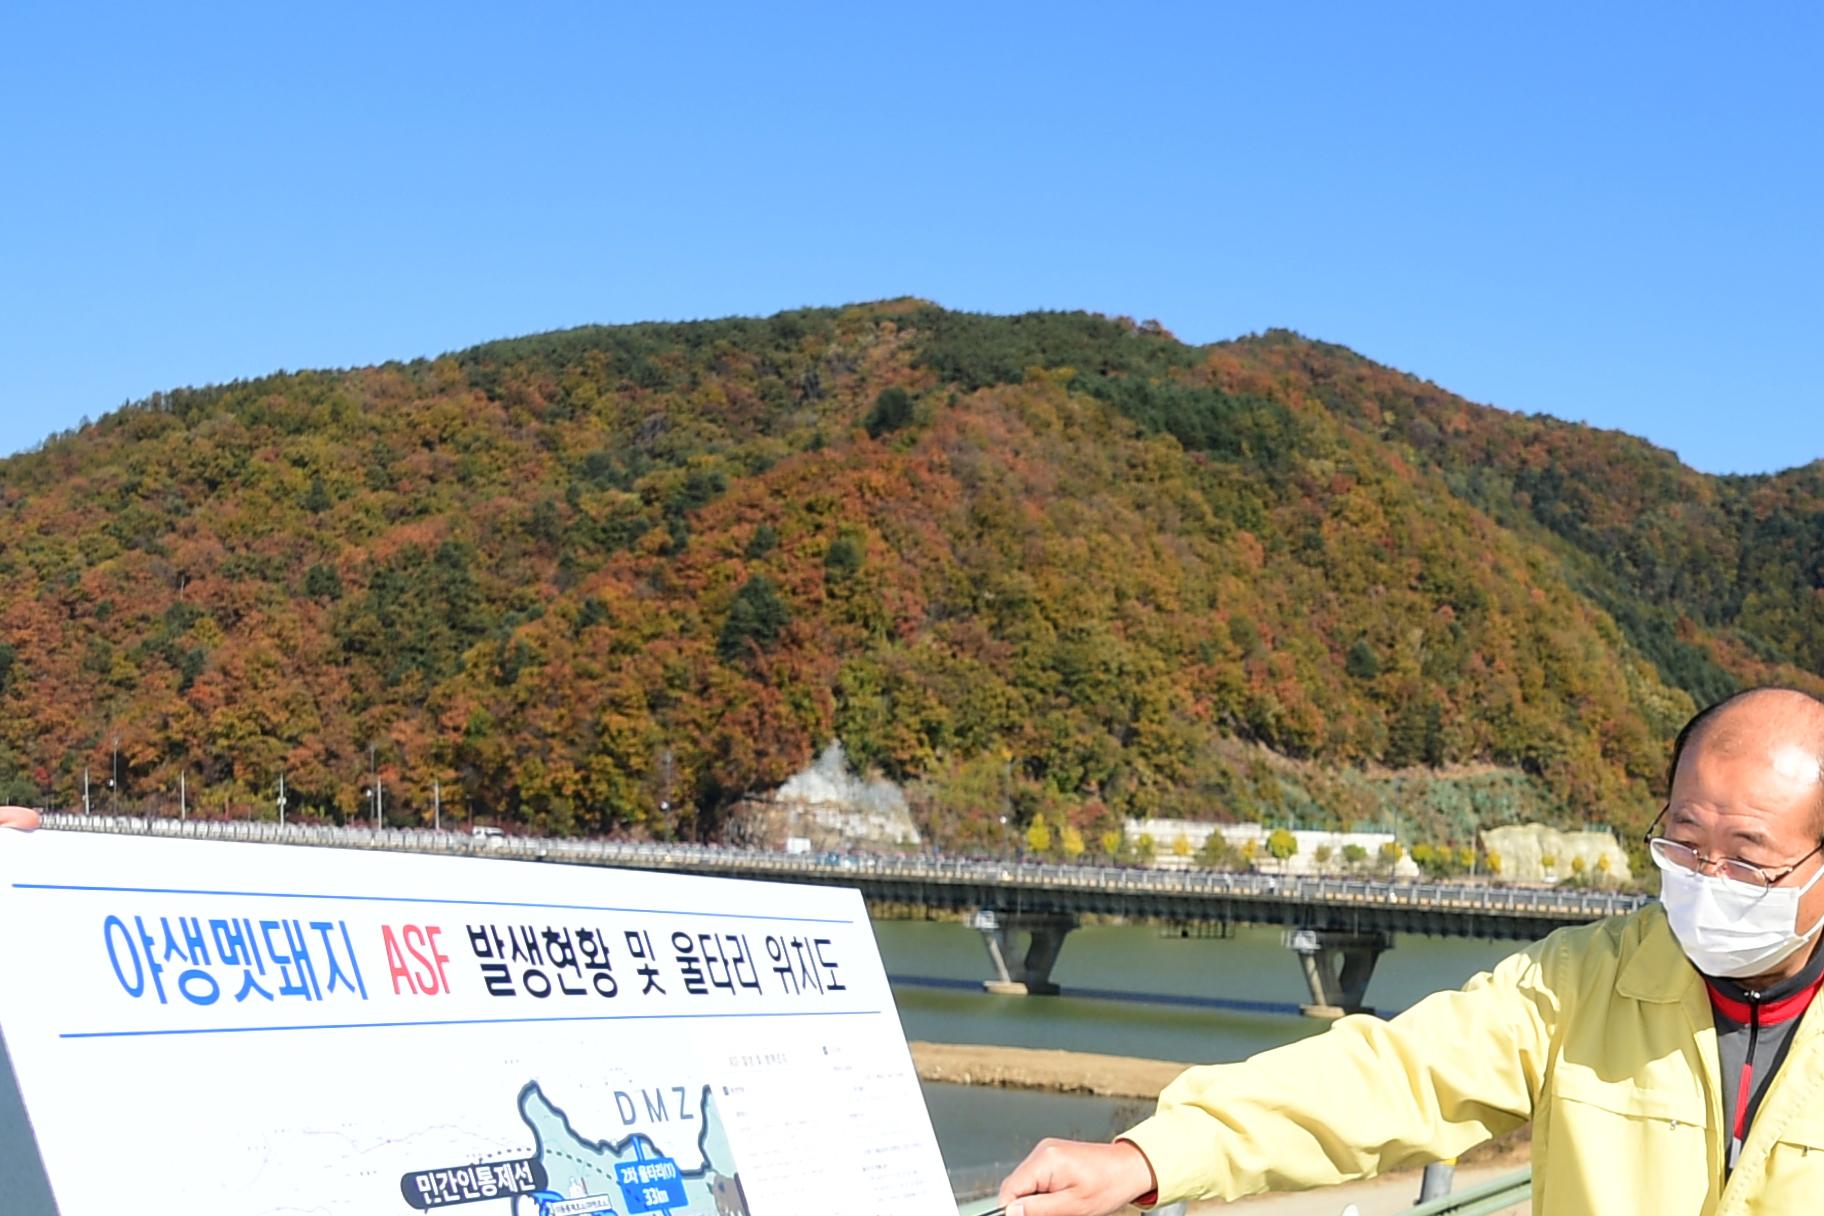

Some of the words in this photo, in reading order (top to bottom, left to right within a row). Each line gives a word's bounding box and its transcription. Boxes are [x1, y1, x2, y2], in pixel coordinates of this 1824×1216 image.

[102, 911, 369, 1005] 야생멧돼지
[381, 922, 451, 996] ASF
[465, 922, 618, 999] 발생현황
[625, 927, 665, 995] 및
[670, 930, 763, 997] 울타리
[772, 932, 847, 995] 위치도
[415, 1163, 535, 1205] 민간인통제선
